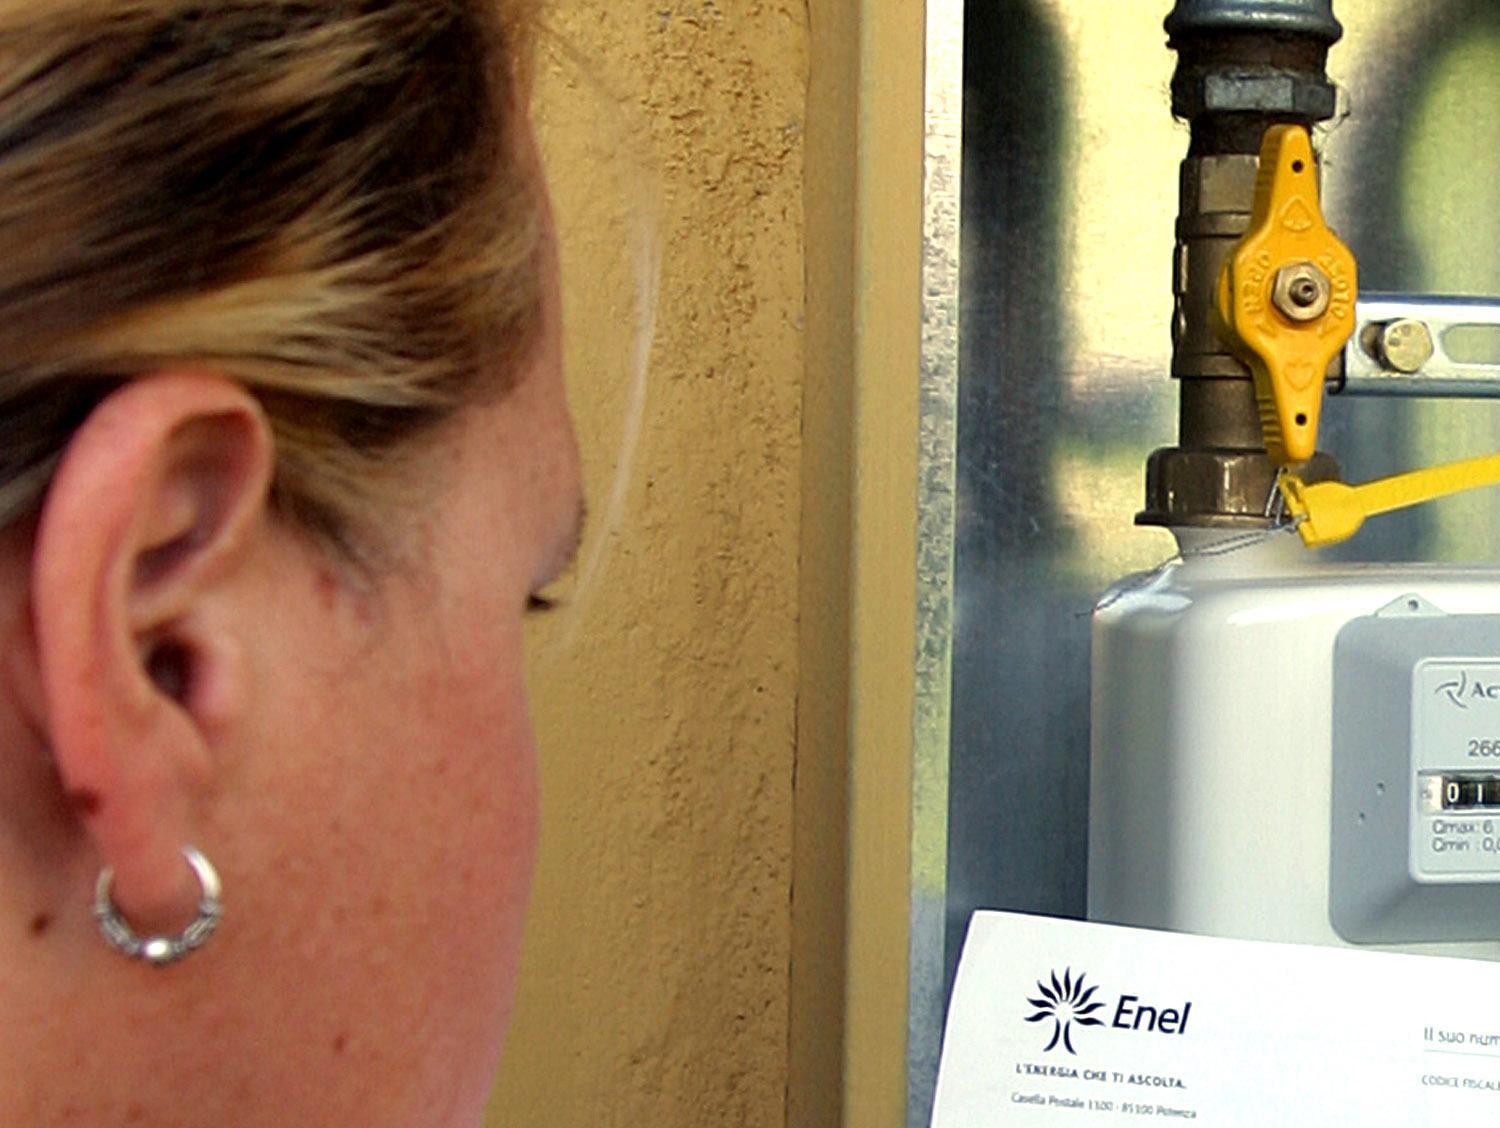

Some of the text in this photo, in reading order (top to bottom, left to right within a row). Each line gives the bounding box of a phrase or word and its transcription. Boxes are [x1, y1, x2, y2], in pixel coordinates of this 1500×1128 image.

[1112, 994, 1193, 1036] Enel
[1424, 1027, 1434, 1041] Il
[1438, 1030, 1465, 1044] suo
[1084, 1069, 1107, 1083] CHE
[1112, 1072, 1124, 1084] TI
